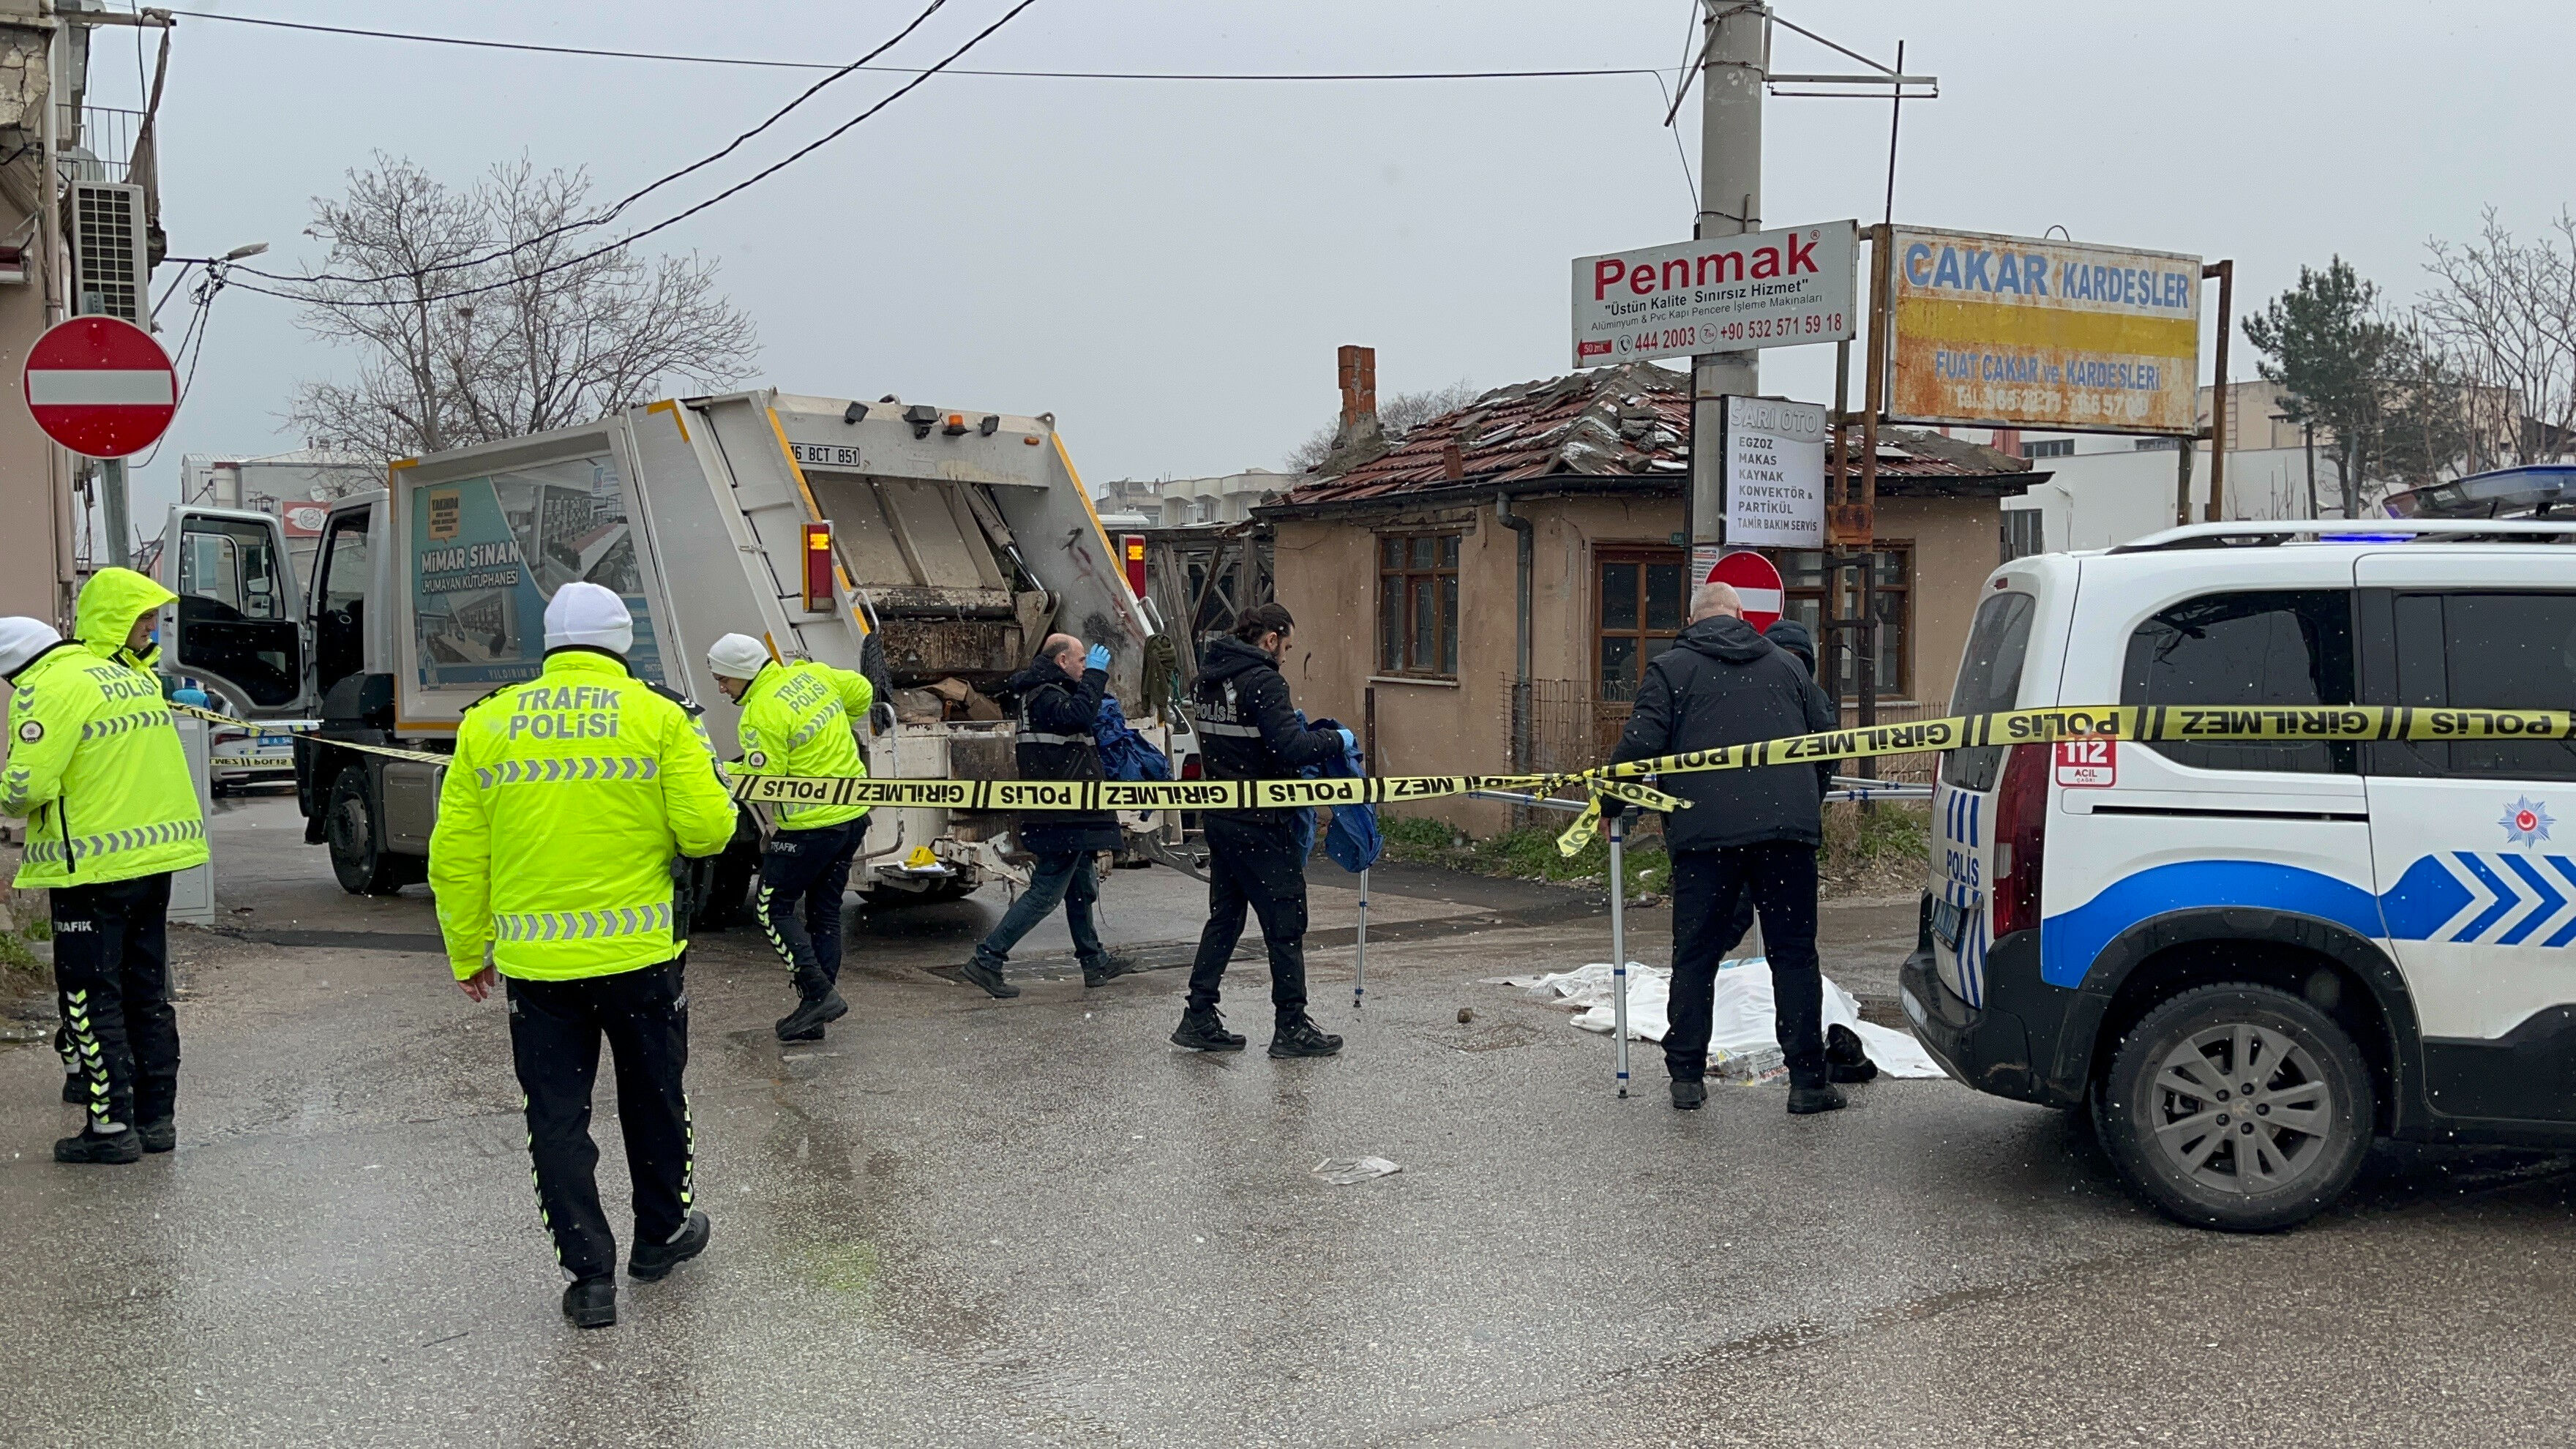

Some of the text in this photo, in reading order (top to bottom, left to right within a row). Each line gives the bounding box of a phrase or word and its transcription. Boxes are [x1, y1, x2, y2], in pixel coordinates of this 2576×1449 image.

[1595, 233, 1819, 301] Penmak
[1651, 296, 1687, 310] Kalite
[1695, 288, 1746, 304] Sınırsız
[1669, 309, 1689, 319] Kapı
[1692, 305, 1731, 317] Pencere
[1721, 312, 1842, 340] +90 532 571 59 18
[1635, 326, 1696, 352] 444 2003
[1935, 351, 1977, 379] FUAT
[1781, 409, 1817, 433] OTO
[809, 446, 830, 463] BCT
[838, 449, 857, 464] 851
[1739, 437, 1773, 450] EGZOZ
[1739, 453, 1777, 465] MAKAS
[1739, 469, 1784, 482] KAYNAK
[1739, 484, 1813, 500] KONVEKTÖR &
[1738, 500, 1794, 514] PARTİKÜL
[1737, 515, 1817, 531] TAMİR BAKIM SERVİS
[469, 540, 520, 568] SİNAN
[517, 686, 622, 711] TRAFİK
[774, 671, 816, 701] TRAFİK
[789, 681, 828, 715] POLİSİ
[509, 713, 618, 740] POLİSİ
[1783, 722, 1952, 758] GİRİLMEZ
[2008, 712, 2119, 738] POLİS
[2180, 711, 2370, 735] GİRİLMEZ
[2431, 712, 2553, 735] POLİS
[2064, 738, 2108, 763] 112
[763, 780, 828, 800] POLİS
[857, 783, 965, 803] GİRİLMEZ
[1000, 785, 1071, 805] POLİS
[1105, 785, 1228, 805] GİRİLMEZ
[1269, 782, 1353, 802] POLİS
[1947, 848, 1980, 888] POLİS
